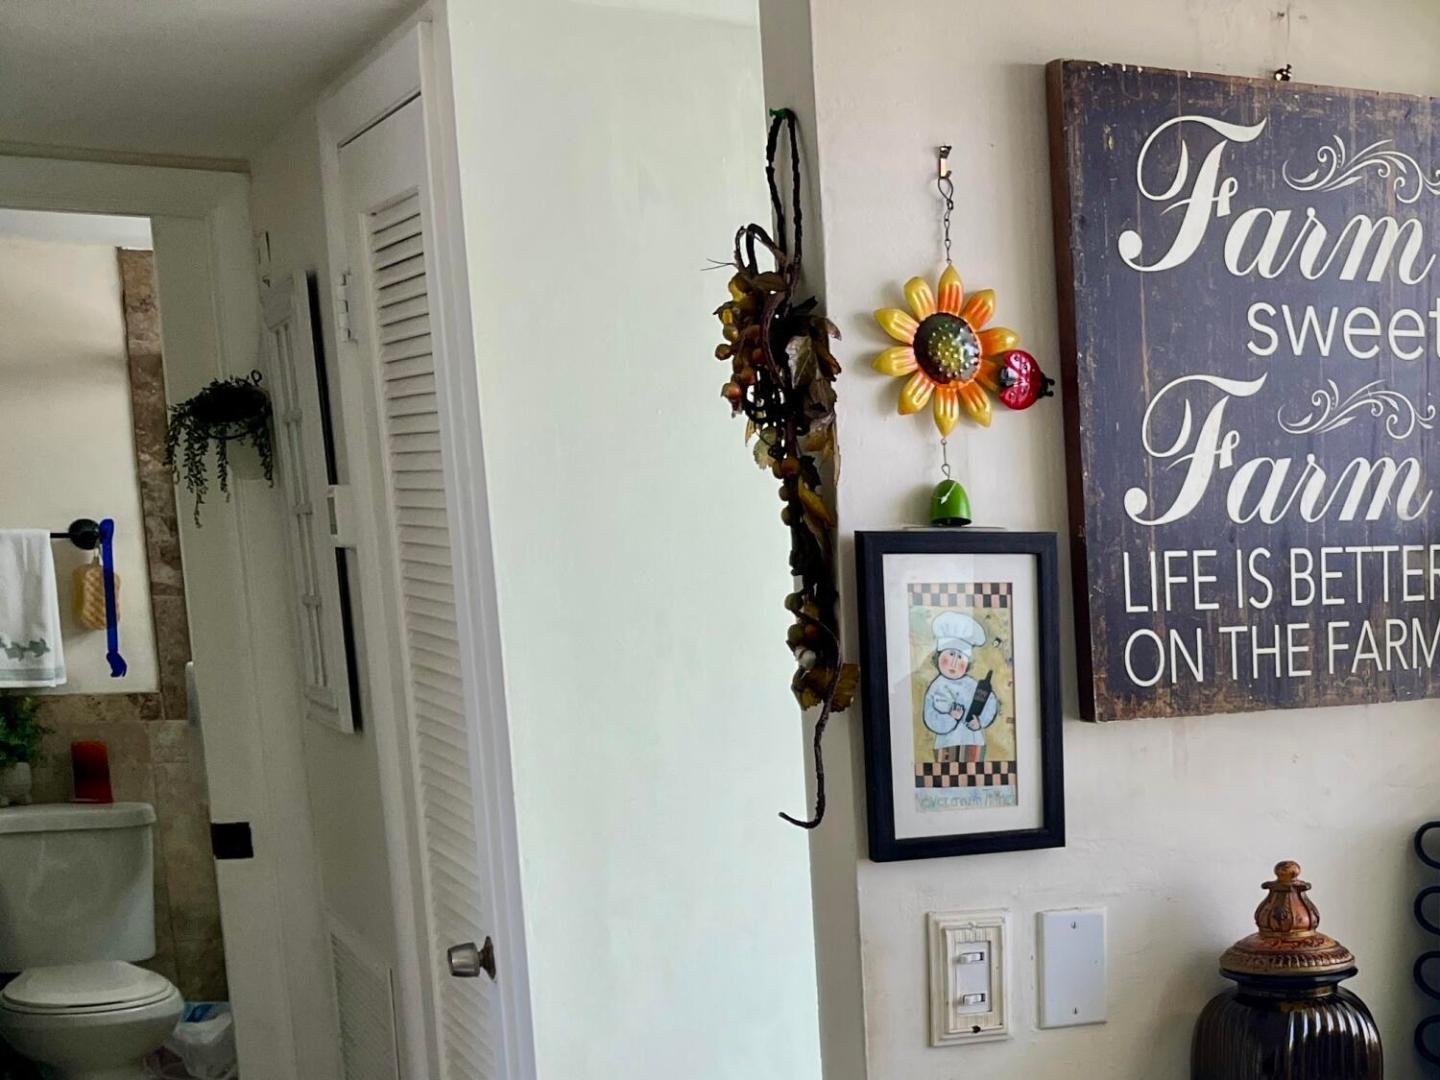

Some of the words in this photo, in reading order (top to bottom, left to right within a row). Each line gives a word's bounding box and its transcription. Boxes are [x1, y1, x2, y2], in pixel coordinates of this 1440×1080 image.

[1118, 115, 1436, 285] Farm
[1124, 372, 1433, 526] Farm
[1123, 549, 1220, 613] LIFE
[1235, 547, 1273, 609] IS
[1124, 628, 1204, 687] ON
[1218, 622, 1312, 680] THE
